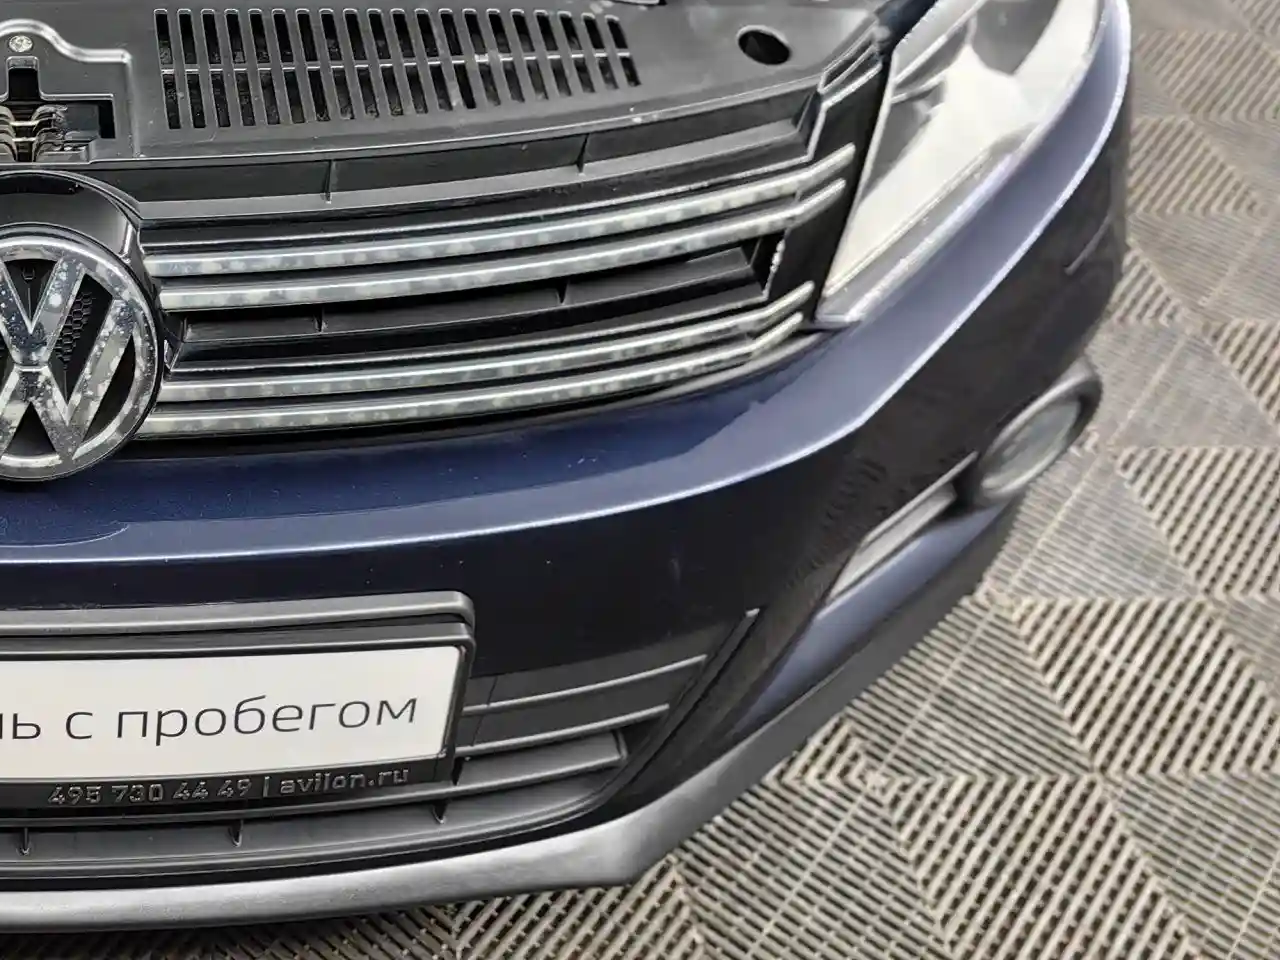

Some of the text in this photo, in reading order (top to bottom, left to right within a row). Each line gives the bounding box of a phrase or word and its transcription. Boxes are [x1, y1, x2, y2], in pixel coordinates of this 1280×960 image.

[65, 709, 94, 740] с
[116, 694, 418, 746] пробегом
[47, 784, 102, 806] 495
[111, 783, 164, 803] 730
[172, 781, 209, 801] 44
[216, 777, 253, 798] 49
[279, 767, 410, 795] avilon.ru
